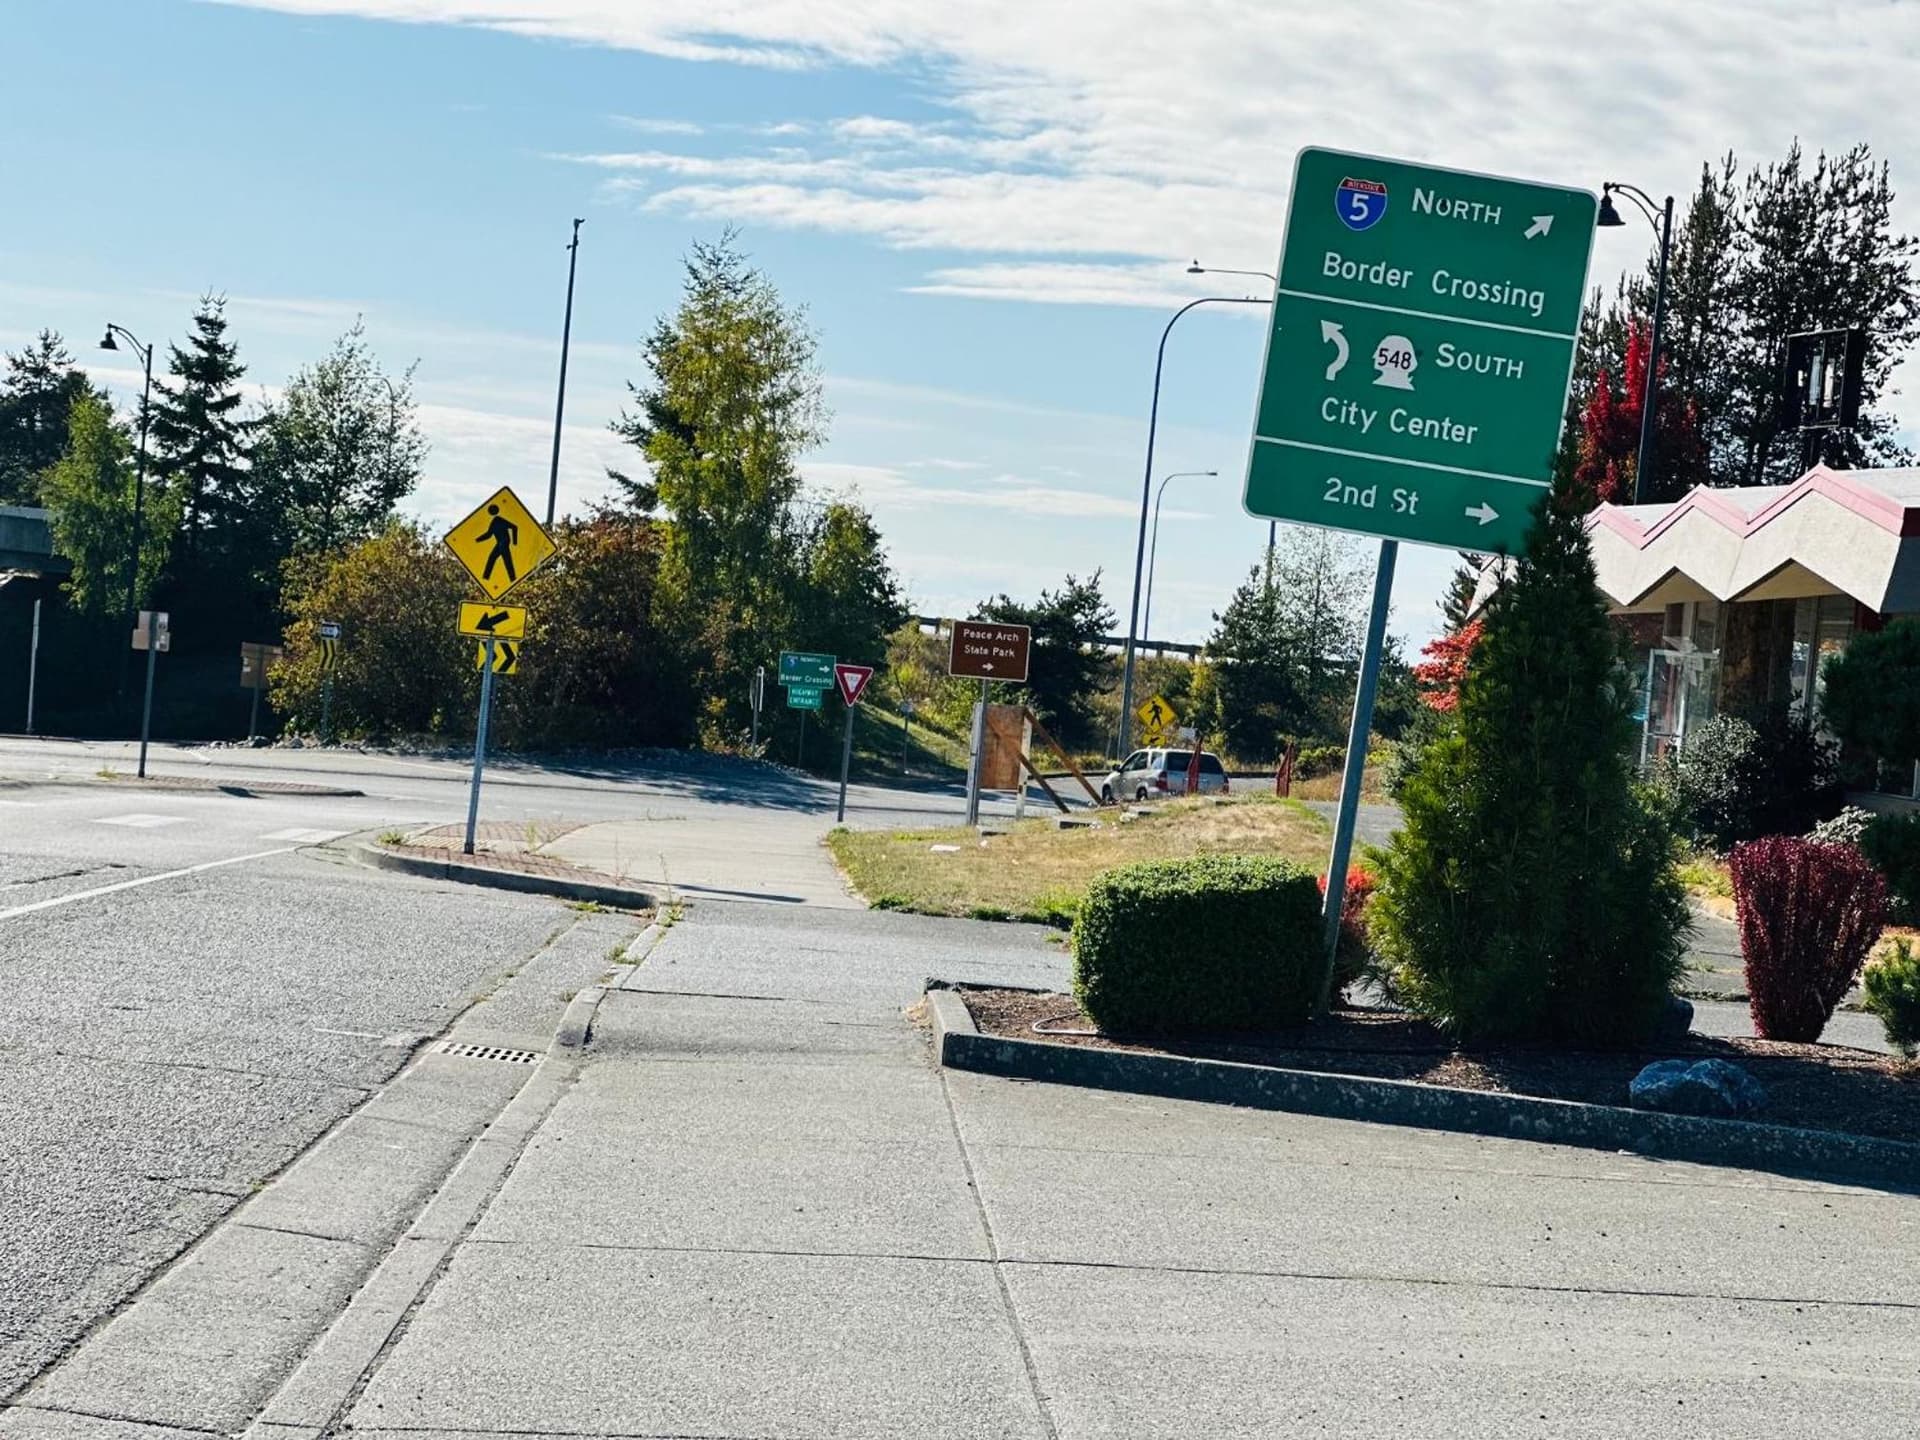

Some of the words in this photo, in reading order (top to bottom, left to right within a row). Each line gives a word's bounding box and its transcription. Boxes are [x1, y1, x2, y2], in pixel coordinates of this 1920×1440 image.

[1349, 193, 1369, 221] 5
[1411, 187, 1502, 225] NORTH
[1323, 251, 1413, 289] Border
[1431, 269, 1545, 317] Crossing
[1377, 348, 1412, 371] 548
[1435, 342, 1524, 380] SOUTH
[1321, 397, 1378, 433] City
[1390, 407, 1478, 445] Center
[1323, 477, 1377, 509] 2nd
[1391, 488, 1419, 515] St
[963, 628, 993, 640] Peace
[995, 631, 1019, 642] Arch
[964, 644, 989, 655] State
[992, 647, 1016, 658] Park
[780, 673, 802, 682] Border
[804, 675, 833, 686] Crossing
